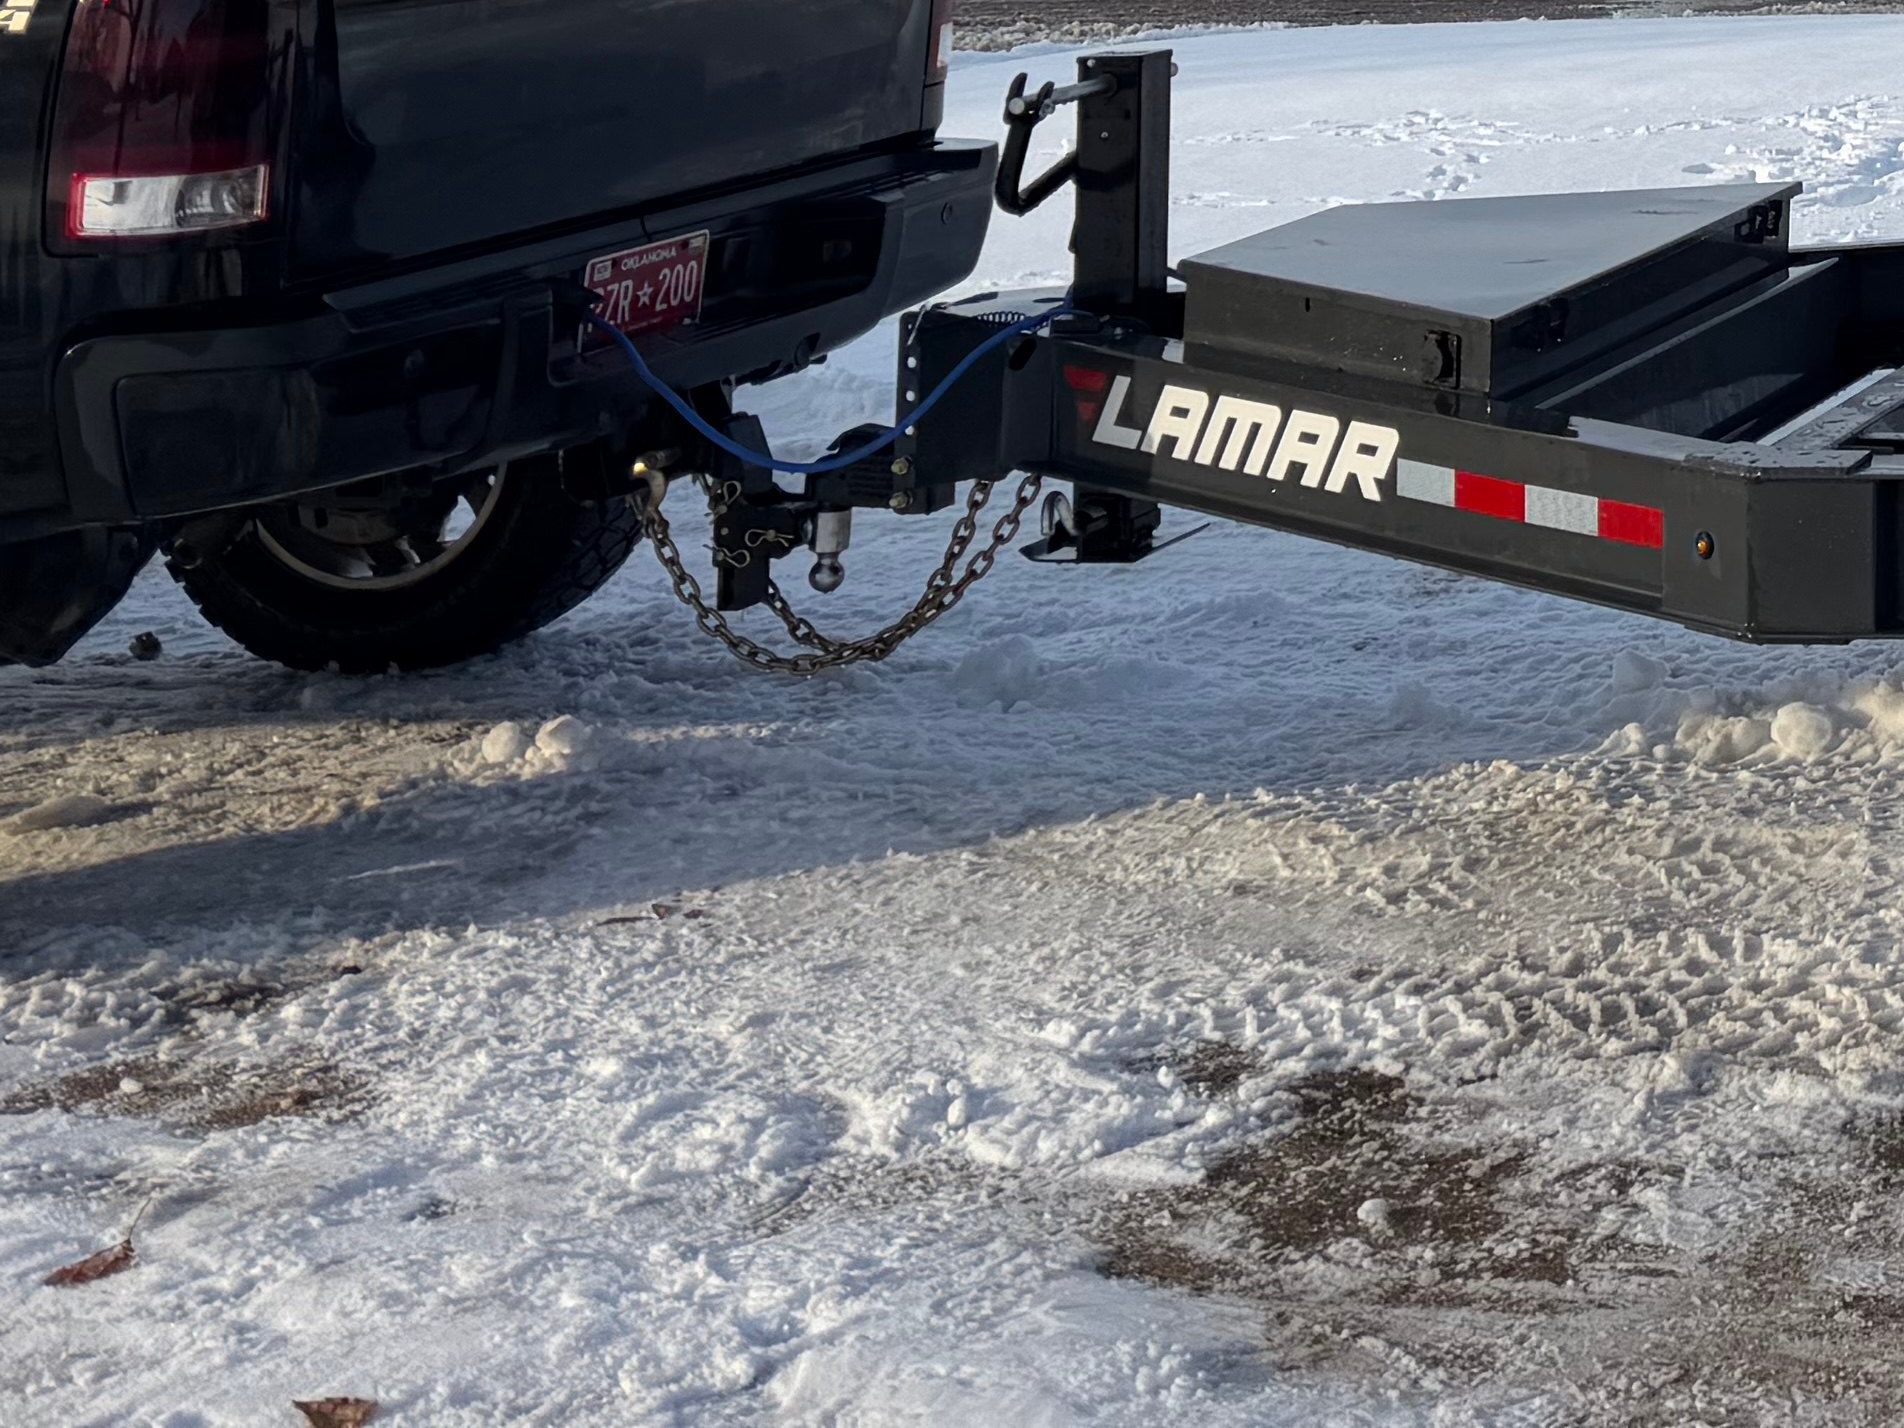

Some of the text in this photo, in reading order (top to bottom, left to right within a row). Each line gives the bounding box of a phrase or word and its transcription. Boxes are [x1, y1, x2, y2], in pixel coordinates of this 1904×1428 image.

[621, 245, 678, 272] OKLAHOMA
[655, 260, 698, 312] 200
[1092, 375, 1400, 502] LAMAR
